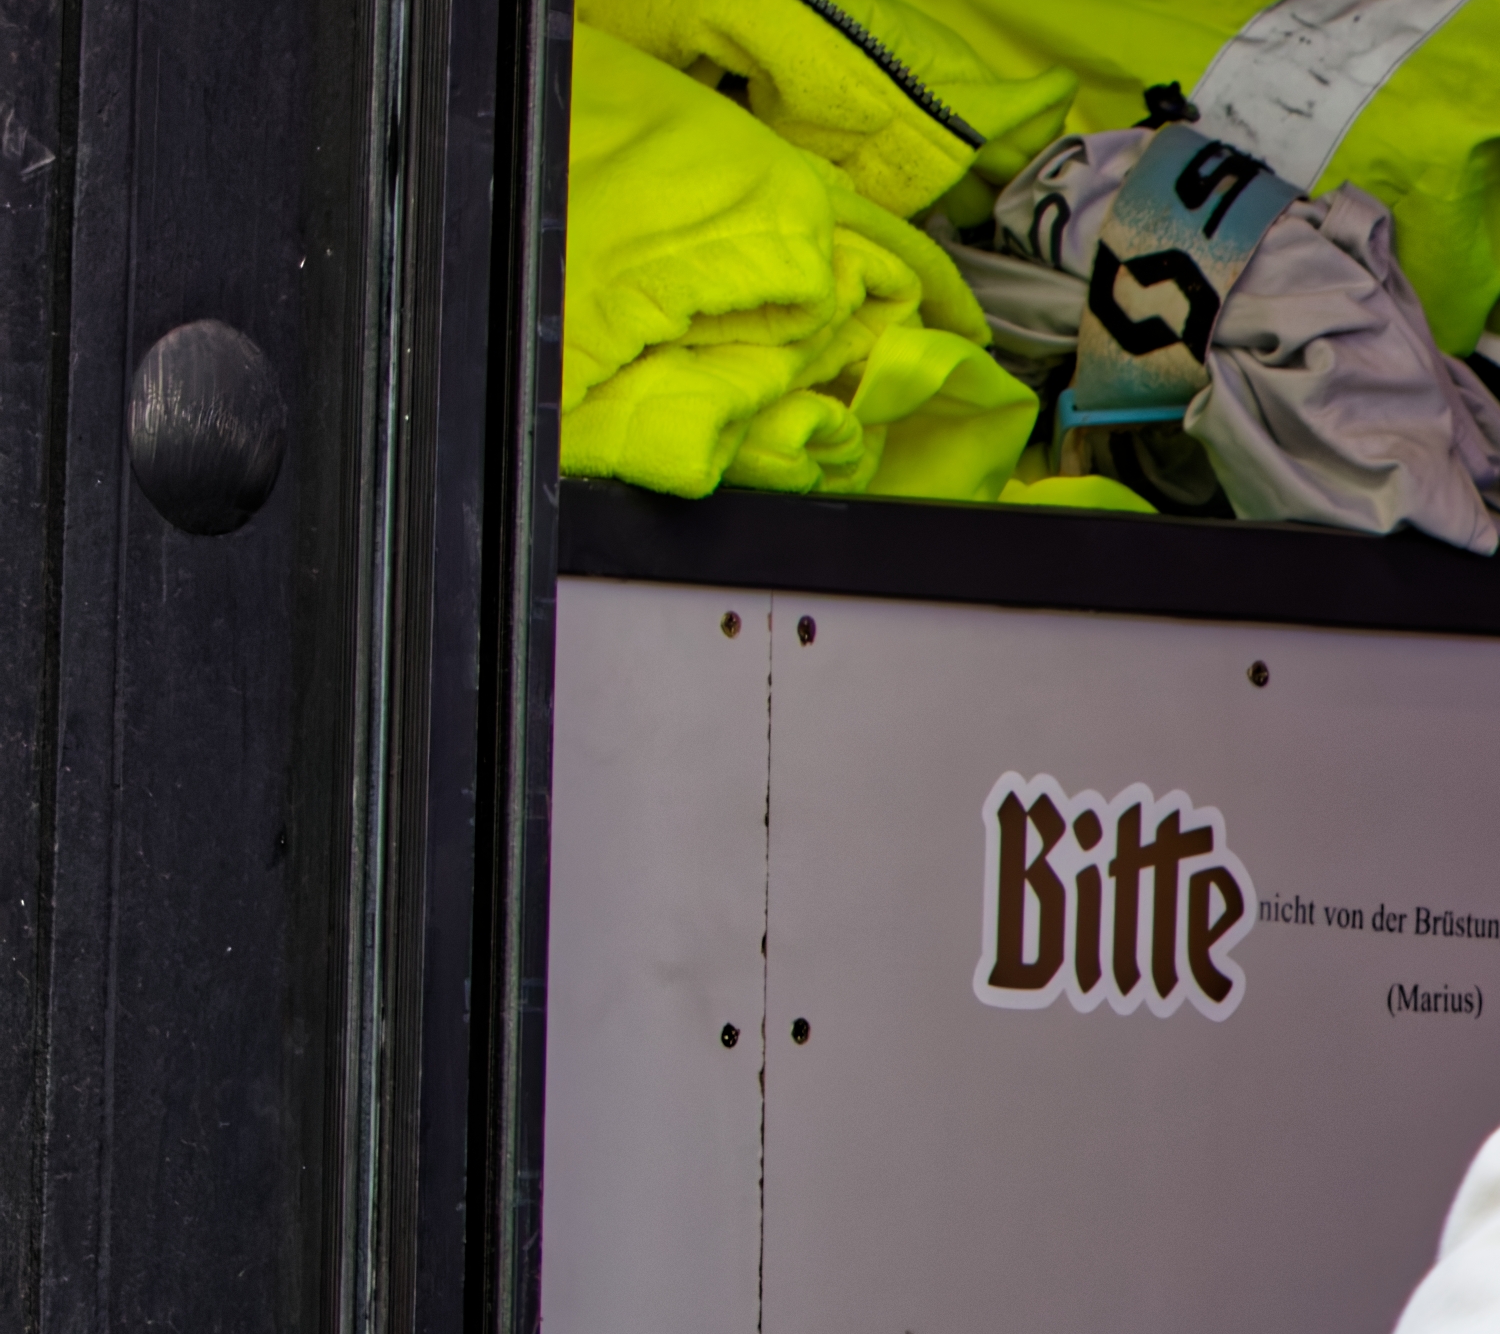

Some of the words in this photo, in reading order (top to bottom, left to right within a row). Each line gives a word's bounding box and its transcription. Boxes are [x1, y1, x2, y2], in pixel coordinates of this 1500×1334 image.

[987, 789, 1246, 1004] Bitte
[1257, 891, 1315, 926] nicht
[1323, 906, 1365, 932] von
[1370, 902, 1408, 936] der
[1385, 981, 1484, 1020] (Marius)
